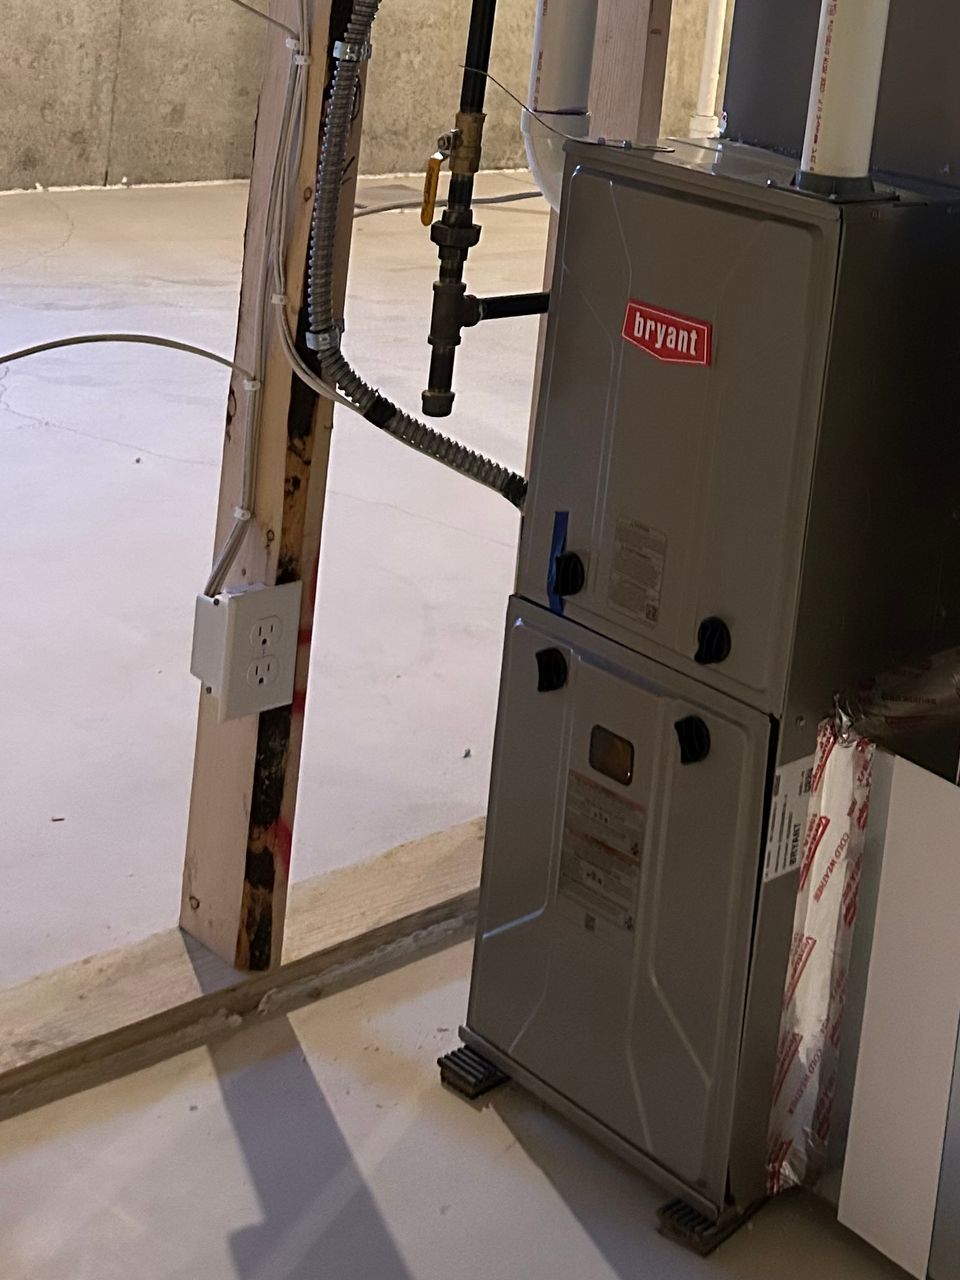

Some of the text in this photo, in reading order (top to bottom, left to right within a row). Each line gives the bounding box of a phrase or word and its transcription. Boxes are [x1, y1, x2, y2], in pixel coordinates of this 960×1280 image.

[633, 311, 698, 357] bryant
[789, 823, 801, 866] BRYANT
[813, 832, 850, 903] COLD WEATHER
